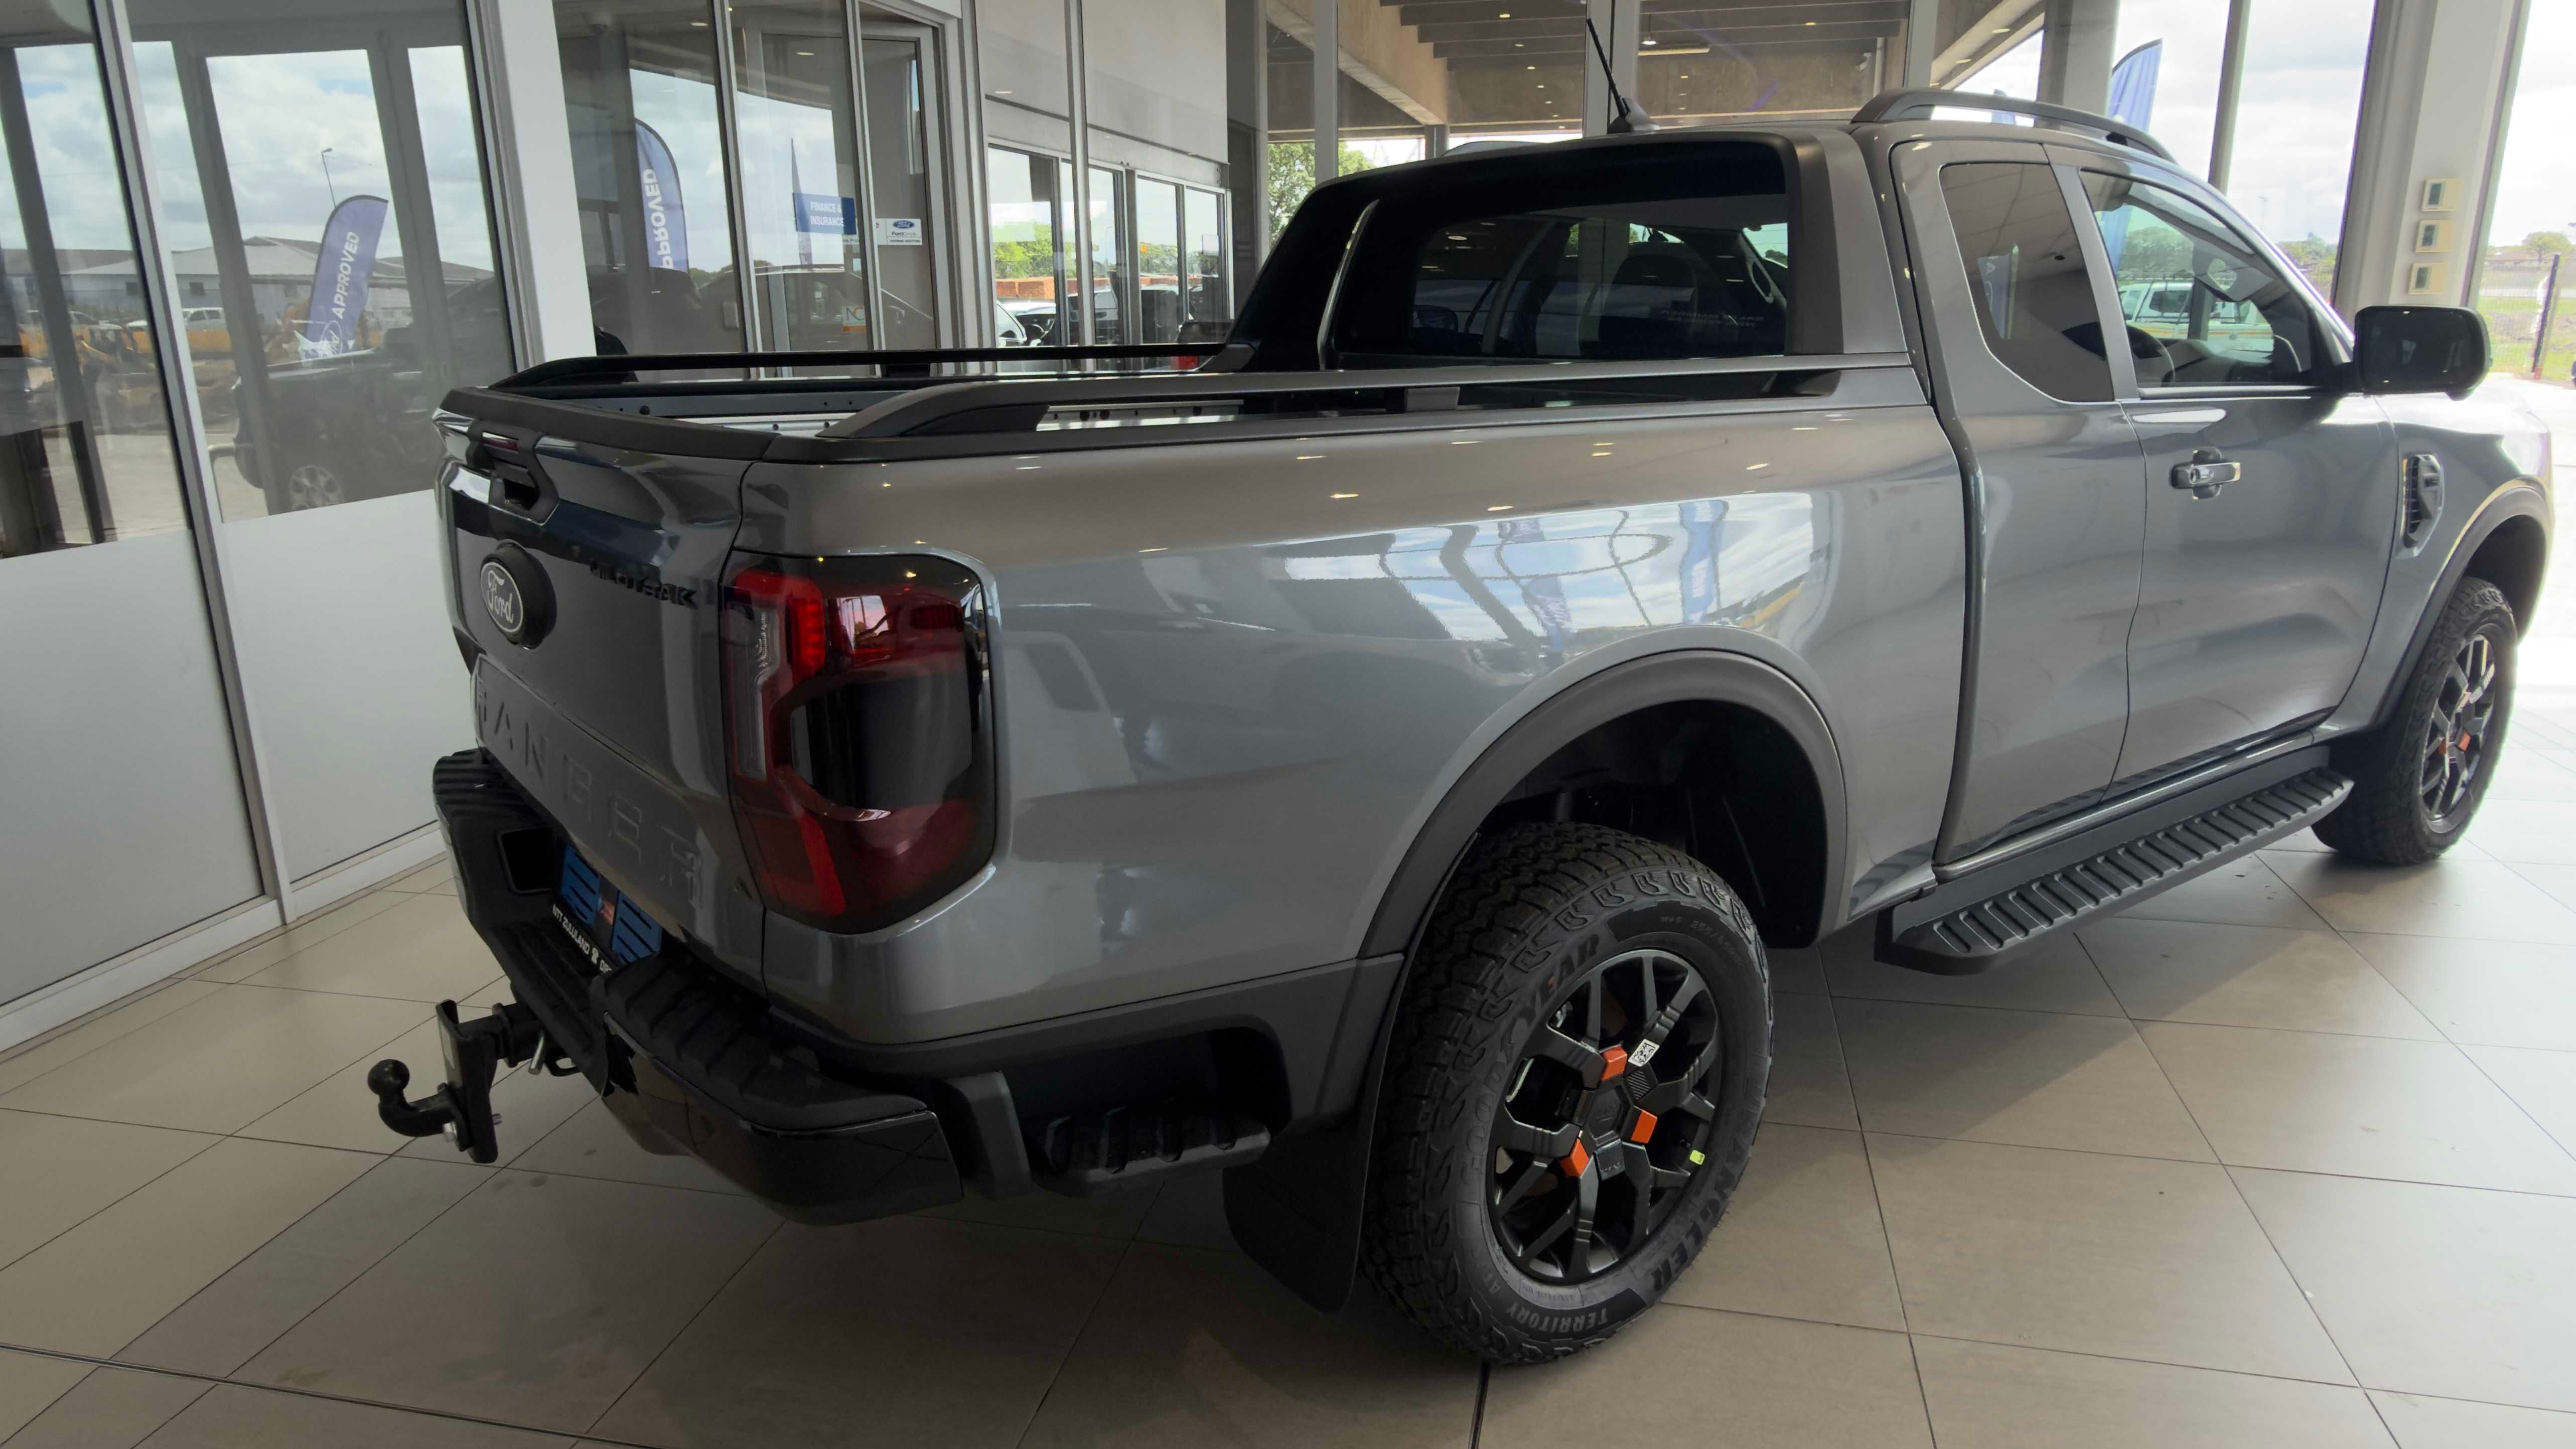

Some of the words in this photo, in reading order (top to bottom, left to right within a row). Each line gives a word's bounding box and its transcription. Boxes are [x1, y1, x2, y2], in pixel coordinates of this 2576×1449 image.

[810, 216, 844, 226] INSURANCE
[811, 202, 836, 213] FINANCE
[331, 231, 359, 320] APPROVED
[487, 569, 514, 624] Ford
[562, 916, 590, 955] ZULULAND
[1505, 1301, 1609, 1333] TERRITORY
